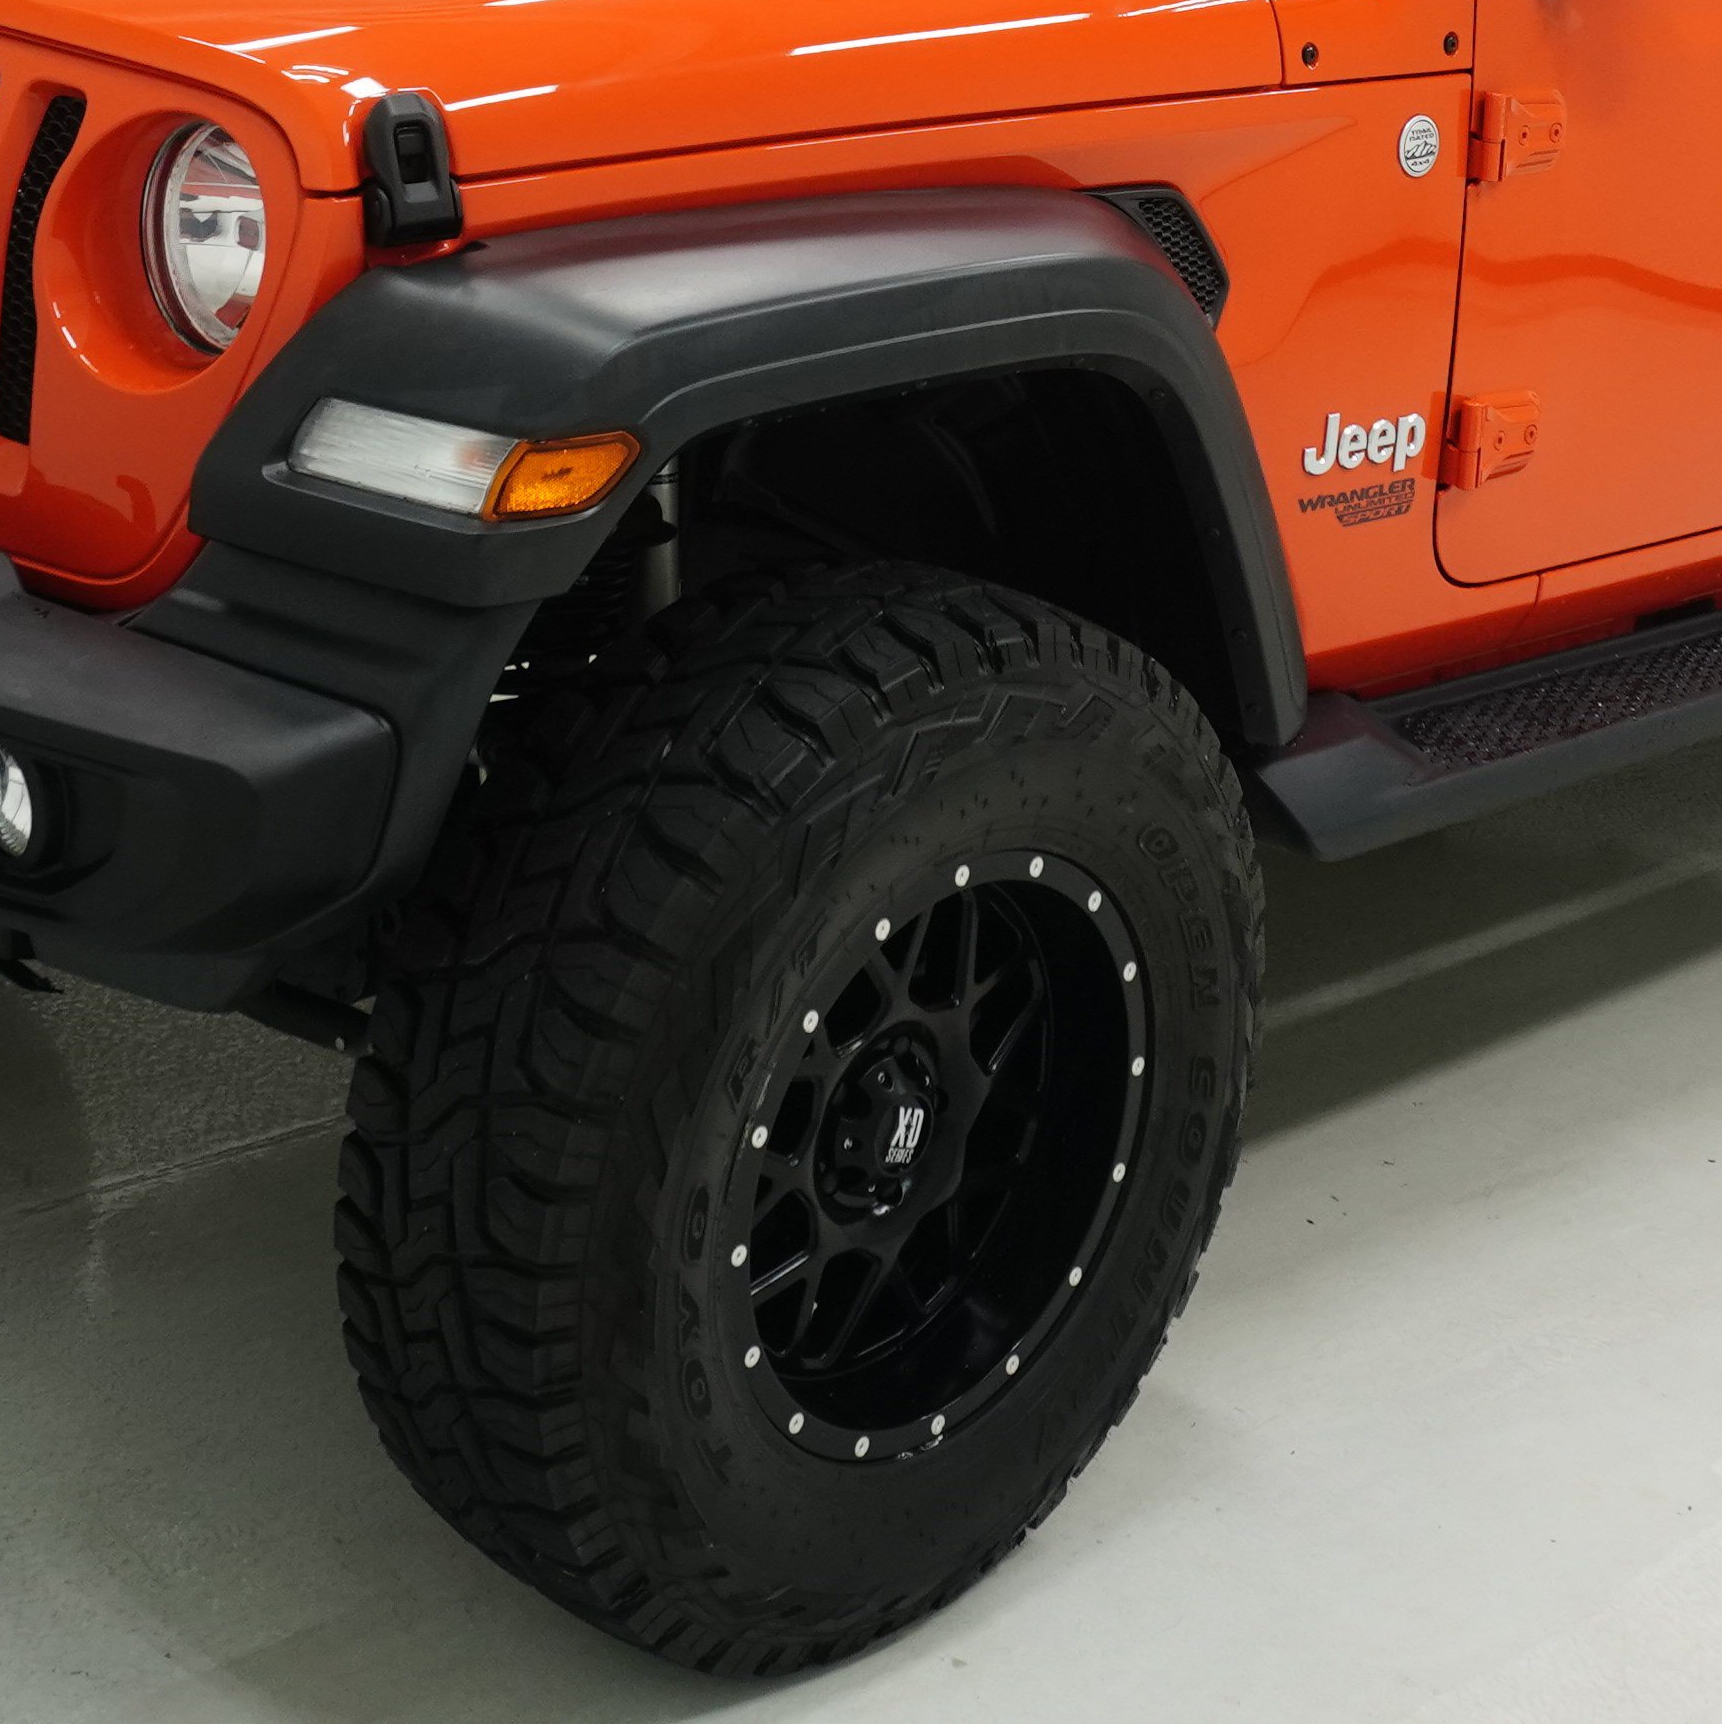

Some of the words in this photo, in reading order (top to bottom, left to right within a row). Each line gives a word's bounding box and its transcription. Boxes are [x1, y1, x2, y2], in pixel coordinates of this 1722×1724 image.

[1302, 412, 1427, 476] Jeep
[1297, 477, 1415, 514] WRANGLER
[1334, 491, 1415, 515] UNLIMITED
[1136, 821, 1222, 1013] OPEN
[889, 1105, 925, 1149] XD
